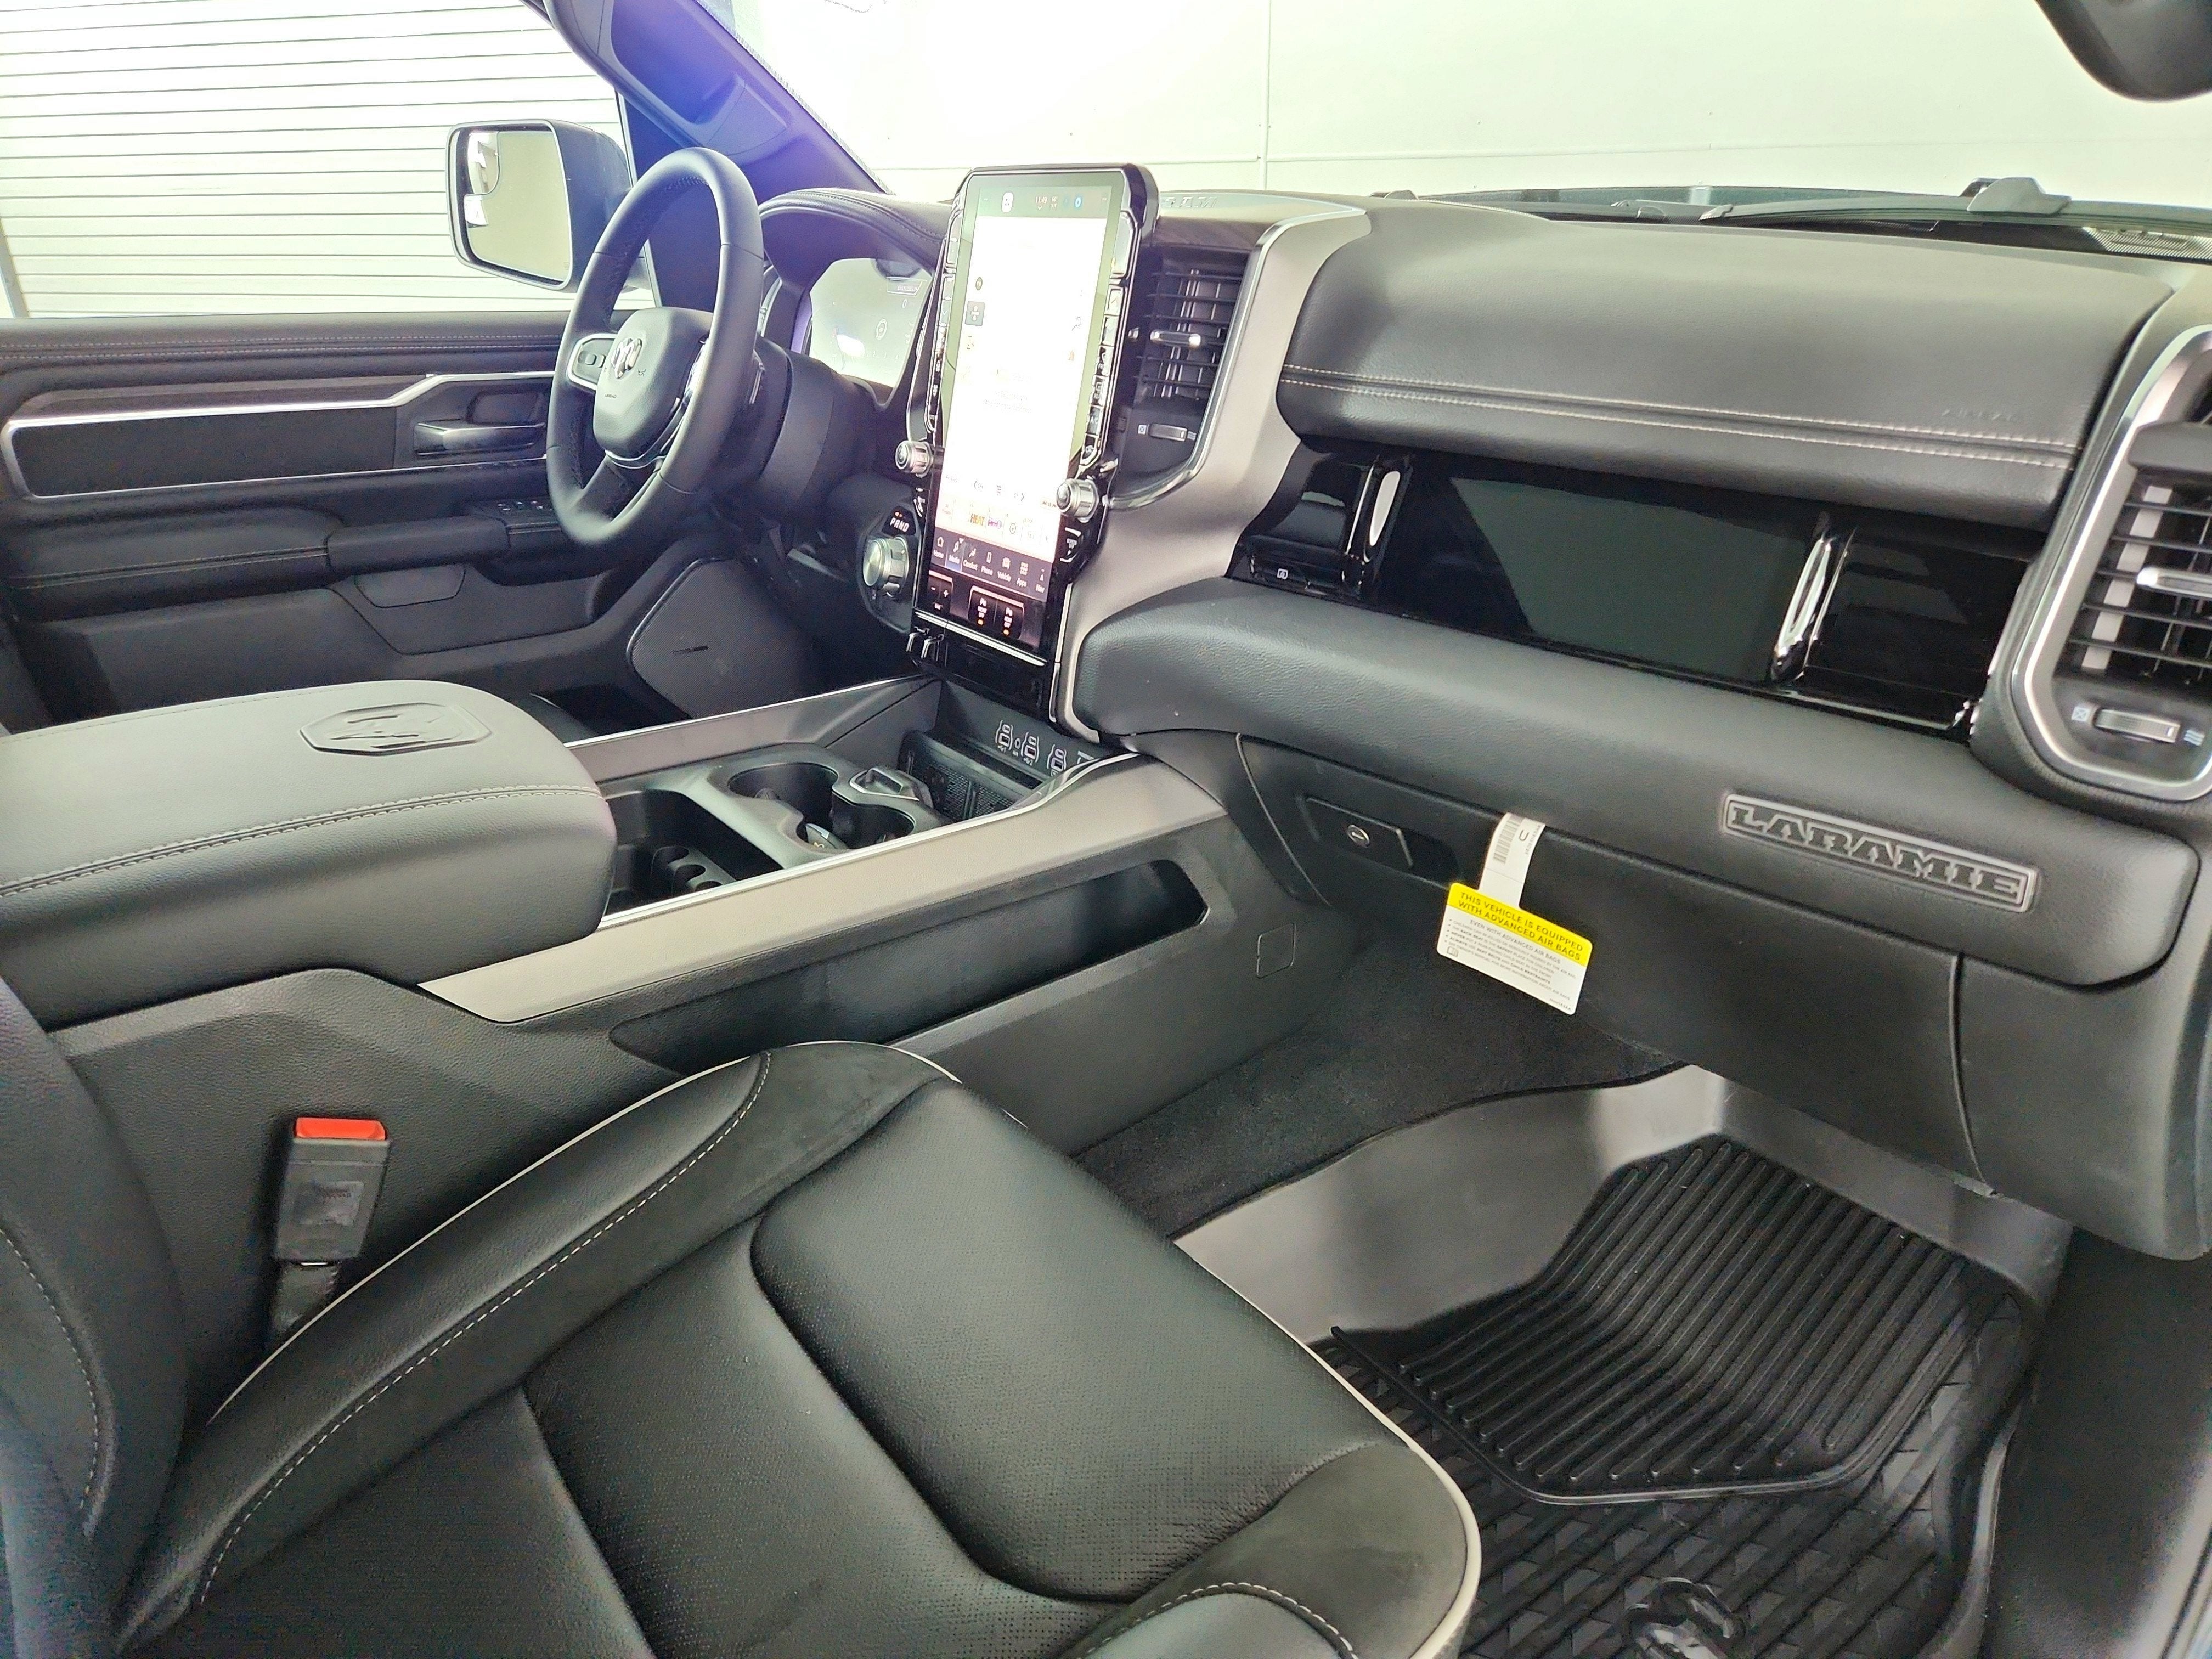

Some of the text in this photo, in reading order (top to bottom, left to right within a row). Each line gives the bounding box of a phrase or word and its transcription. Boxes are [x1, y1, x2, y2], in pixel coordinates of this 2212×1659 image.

[970, 513, 985, 527] HEAT
[933, 550, 944, 559] Home
[949, 555, 960, 565] Media
[963, 560, 978, 571] Comfort
[981, 566, 994, 576] Phone
[997, 571, 1012, 582] Vehicle
[1016, 578, 1028, 588] Apps
[1036, 584, 1045, 594] Nav
[1519, 830, 1530, 841] U
[1730, 804, 2022, 901] LARAMIE
[1460, 892, 1481, 905] THIS
[1484, 901, 1522, 922] VEHICLE
[1525, 919, 1533, 928] IS
[1536, 925, 1583, 952] EQUIPPED
[1459, 901, 1482, 915] WITH
[1484, 912, 1535, 938] ADVANCED
[1538, 935, 1554, 946] AIR
[1556, 944, 1581, 961] BAGS
[1470, 919, 1486, 929] EVEN
[1487, 926, 1502, 936] WITH
[1502, 934, 1533, 951] ADVANCED
[1545, 953, 1561, 964] BAGS
